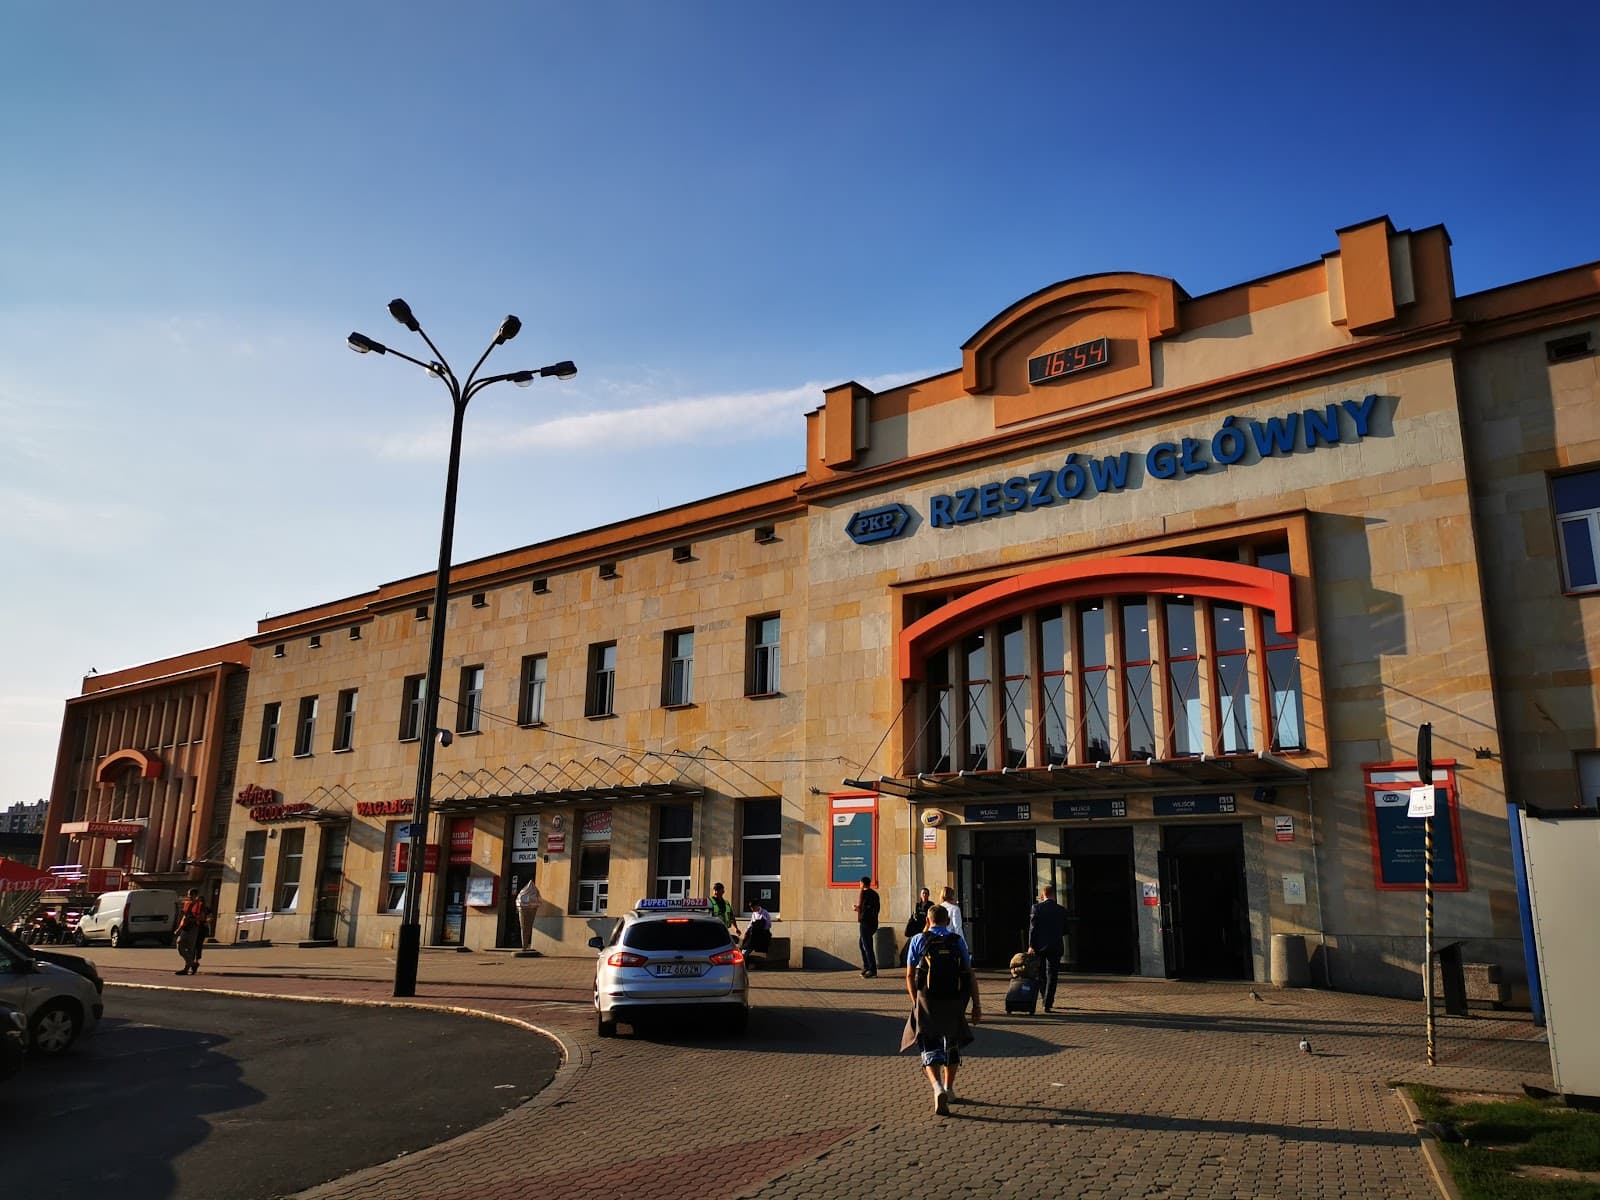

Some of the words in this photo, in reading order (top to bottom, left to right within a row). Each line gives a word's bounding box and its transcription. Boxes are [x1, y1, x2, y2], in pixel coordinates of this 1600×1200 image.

[1045, 343, 1103, 377] 16:54
[856, 513, 894, 534] PKP
[930, 452, 1129, 528] RZESZÓW
[1146, 394, 1377, 479] GŁÓWNY
[643, 898, 667, 907] SUPER
[667, 899, 682, 907] TAXI
[662, 964, 673, 974] RZ
